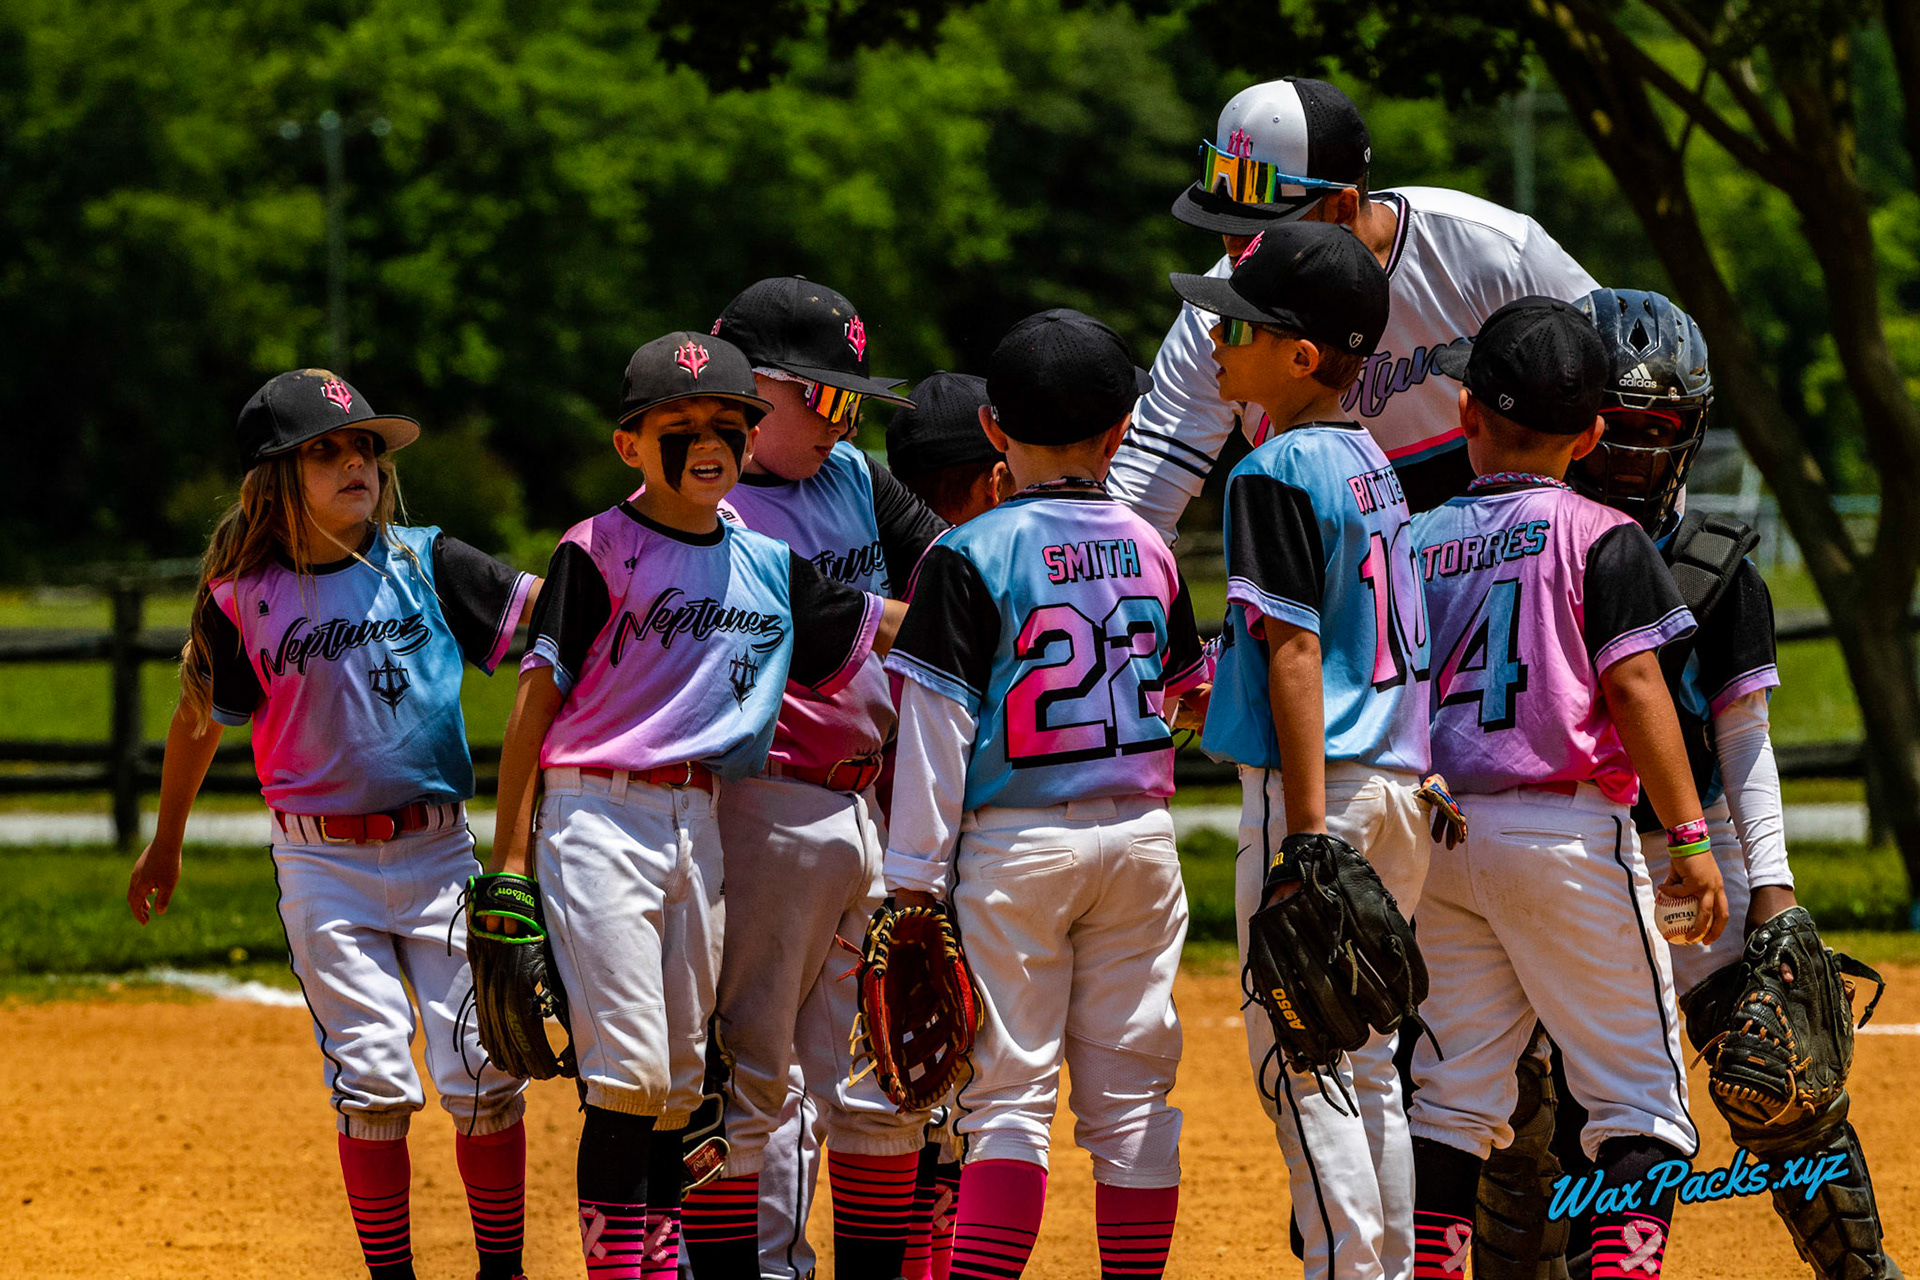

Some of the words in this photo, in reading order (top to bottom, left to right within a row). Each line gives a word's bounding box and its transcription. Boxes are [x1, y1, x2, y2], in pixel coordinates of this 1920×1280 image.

[1618, 378, 1658, 389] adidas
[1347, 465, 1405, 516] RITTE
[1042, 539, 1142, 585] SMITH
[1422, 520, 1550, 582] TORRES
[610, 587, 784, 668] Neptunez
[1358, 520, 1431, 694] 10
[260, 613, 433, 686] Neptunez
[1435, 577, 1528, 733] 4
[1003, 596, 1175, 769] 22
[497, 887, 534, 908] Wilson
[1663, 911, 1697, 922] OFFICIAL
[1271, 988, 1306, 1030] A950
